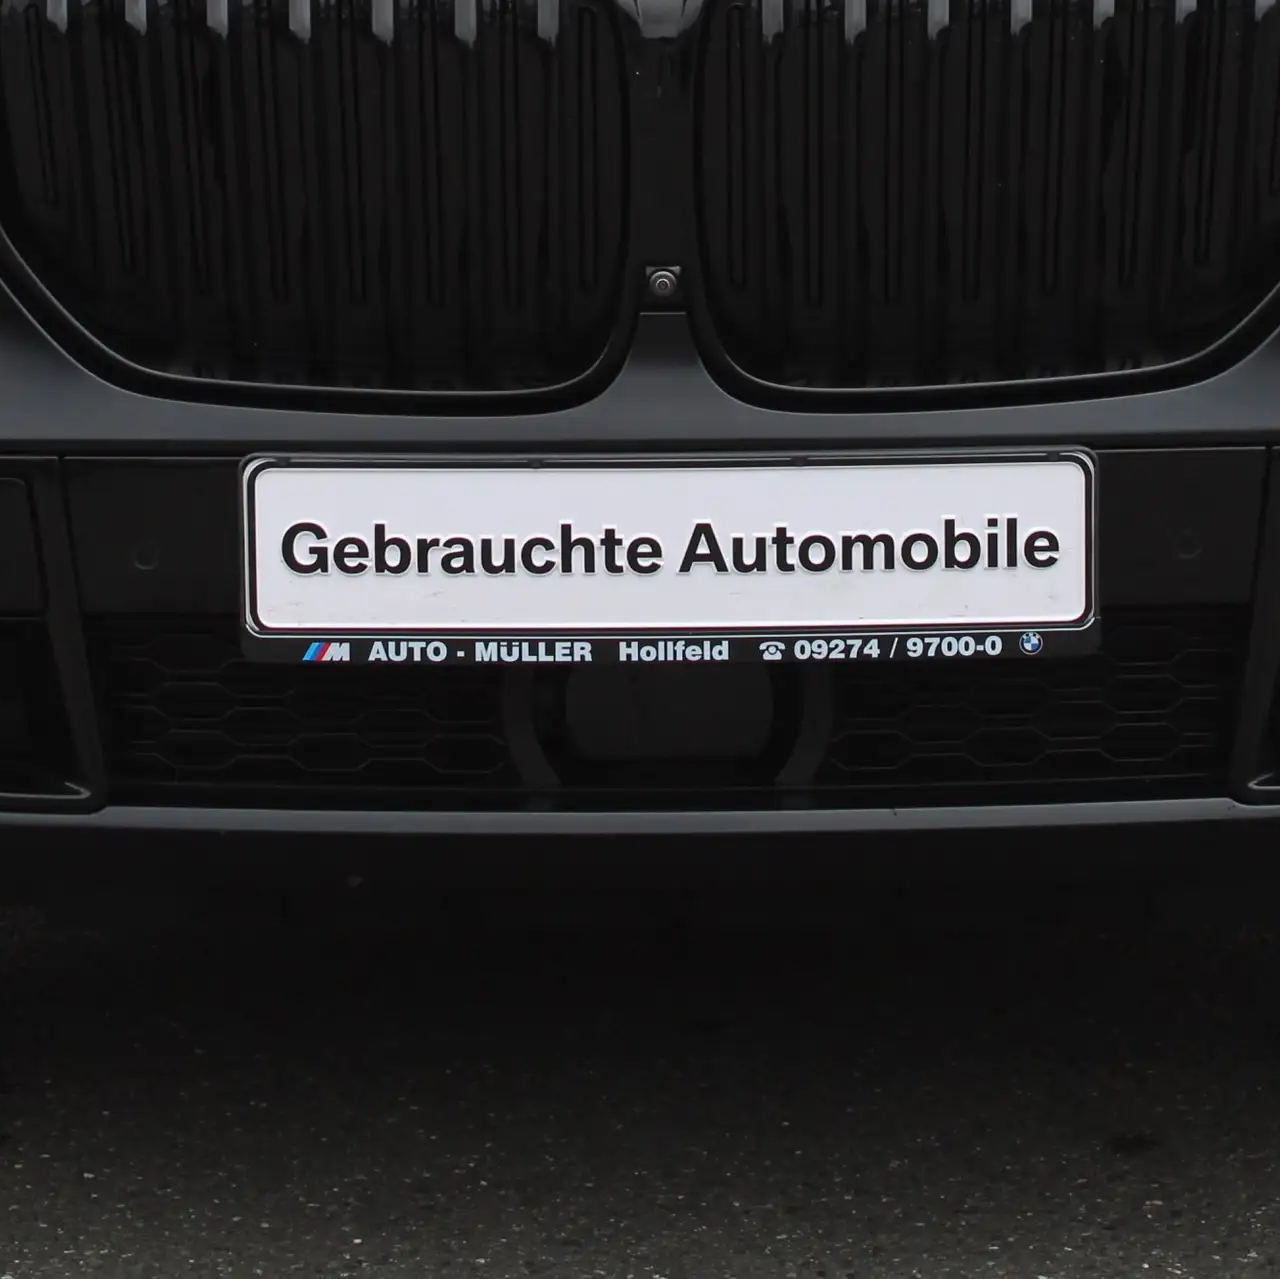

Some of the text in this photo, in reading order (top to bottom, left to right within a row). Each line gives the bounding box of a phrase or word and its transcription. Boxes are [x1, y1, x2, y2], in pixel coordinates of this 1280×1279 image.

[280, 516, 1062, 575] Gebrauchte Automobile
[368, 640, 448, 662] AUTO
[619, 640, 730, 662] Hollfeld
[793, 638, 881, 660] 09274
[906, 635, 1003, 658] 9700-0
